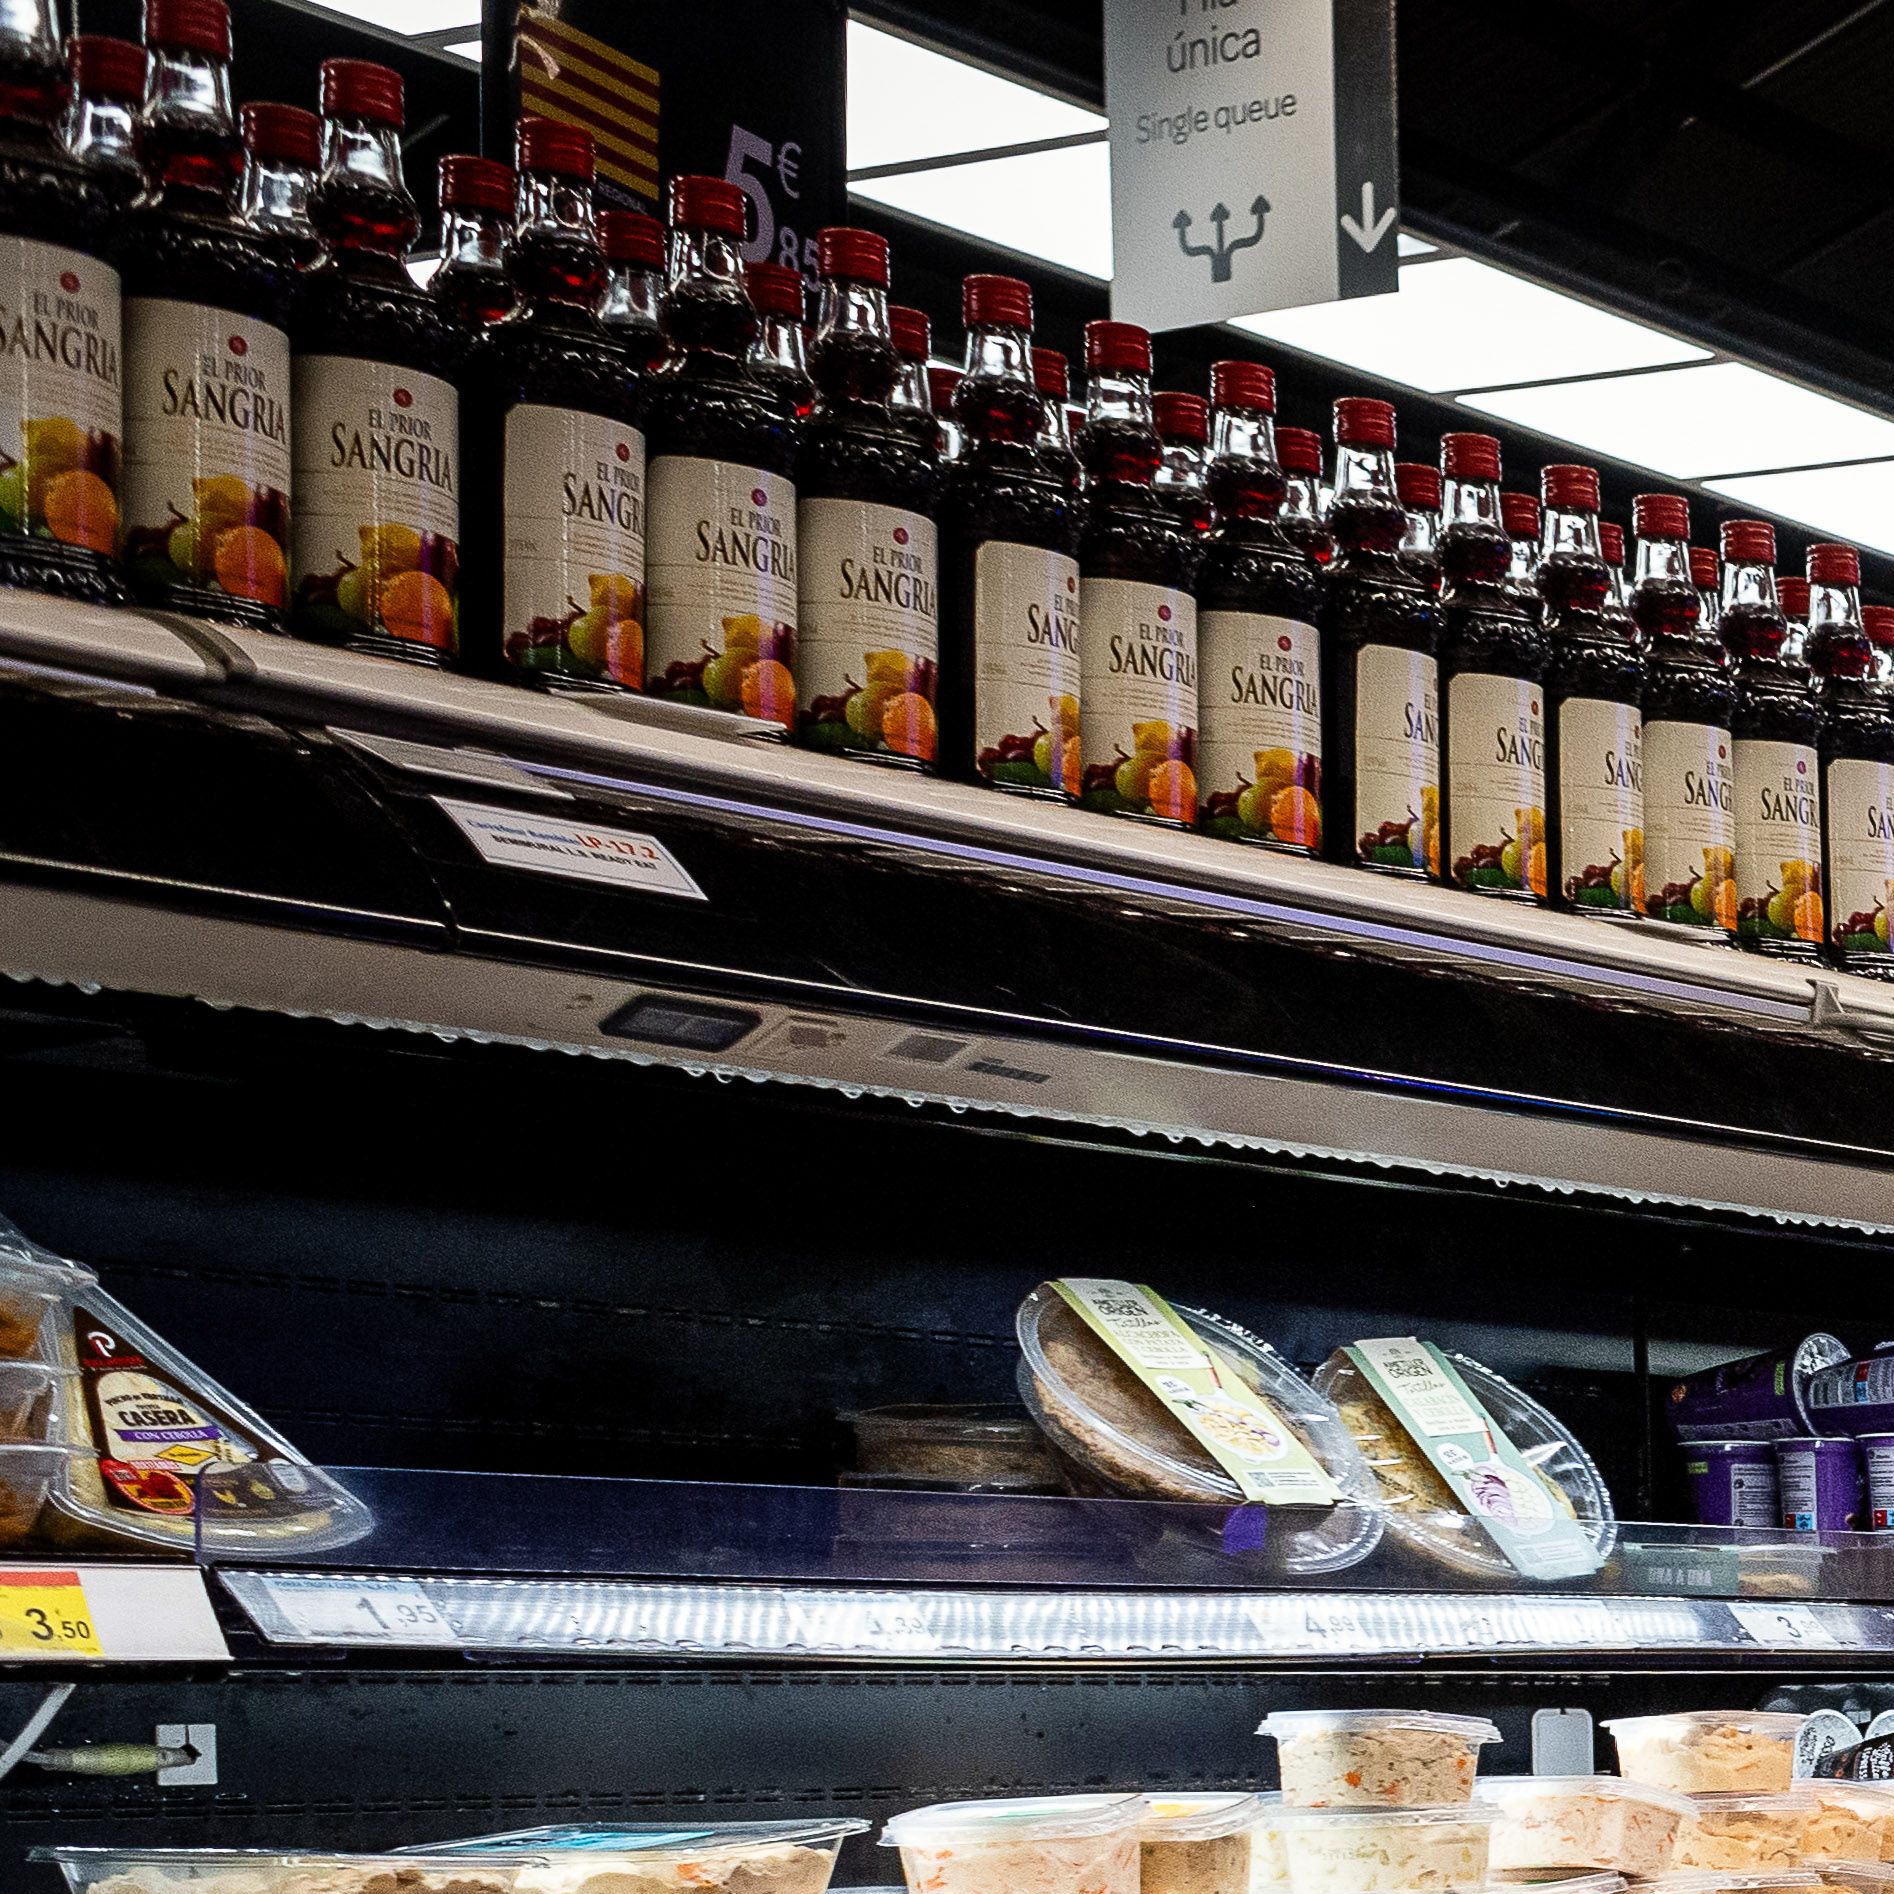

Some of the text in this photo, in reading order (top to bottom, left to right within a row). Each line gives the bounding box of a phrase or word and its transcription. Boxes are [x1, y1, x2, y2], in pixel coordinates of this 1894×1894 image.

[1167, 25, 1260, 72] única
[1137, 94, 1297, 145] Single queue
[726, 124, 775, 264] 5
[34, 292, 50, 318] EL
[0, 312, 119, 386] ANGRIA
[202, 355, 266, 391] EL PRIOR
[162, 368, 287, 445] SANGRIA
[368, 408, 431, 440] EL PRIOR
[330, 422, 453, 492] SANGRIA
[563, 473, 644, 533] SANGR
[696, 520, 795, 579] SANGRI
[873, 545, 885, 564] EL
[1027, 603, 1080, 654] SANG
[1109, 634, 1197, 688] SANGRI
[1260, 653, 1271, 671] EL
[1761, 787, 1819, 829] SANGR
[118, 1407, 196, 1428] CASERA
